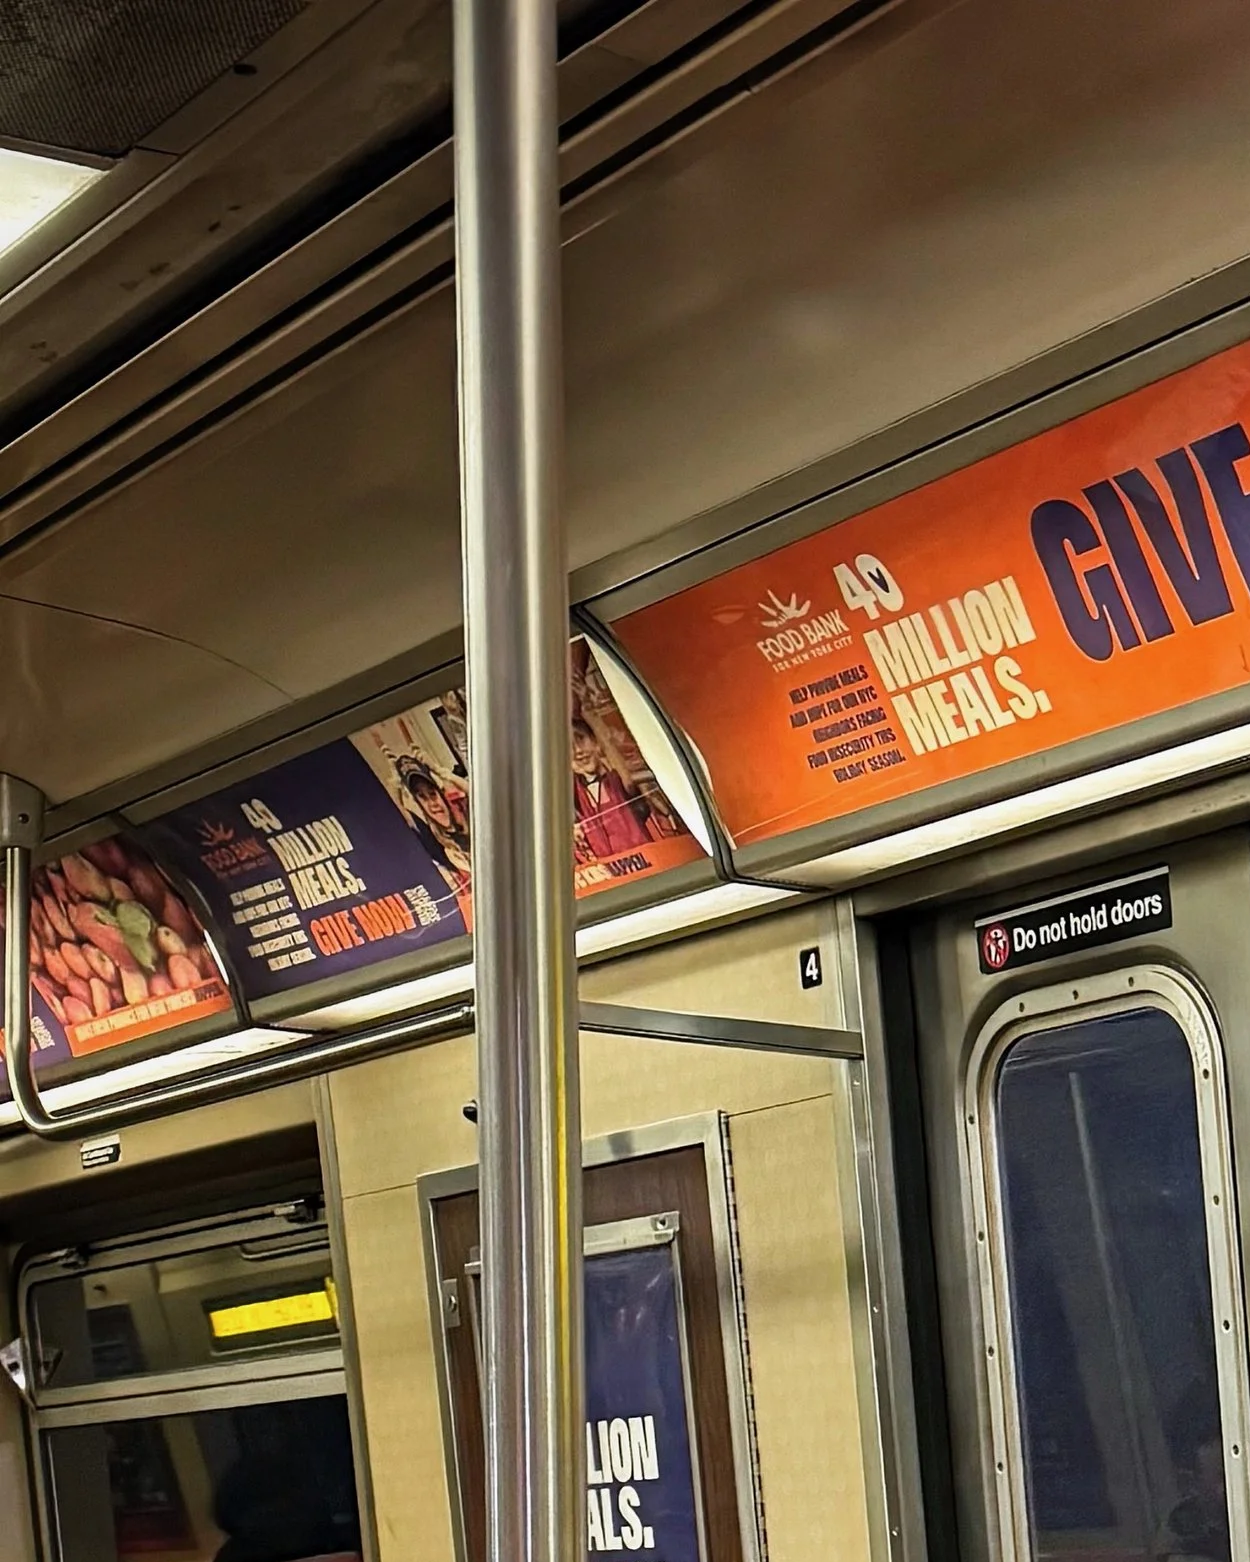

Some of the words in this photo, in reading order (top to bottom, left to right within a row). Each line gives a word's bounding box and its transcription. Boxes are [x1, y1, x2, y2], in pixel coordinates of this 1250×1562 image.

[832, 553, 904, 620] 40
[756, 629, 805, 662] FOOD
[800, 609, 850, 645] BANK
[833, 635, 853, 650] CITY
[863, 575, 1037, 692] MILLION
[890, 656, 1053, 756] MEALS.
[267, 815, 354, 873] MILLION
[288, 856, 367, 911] MEALS.
[310, 909, 366, 957] GIVE
[351, 892, 417, 942] NOW
[1012, 926, 1037, 953] Do
[1039, 917, 1068, 945] not
[1069, 903, 1108, 937] hold
[1110, 893, 1163, 926] doors
[805, 952, 819, 981] 4
[586, 1415, 660, 1485] LION
[587, 1485, 655, 1551] ALS.
